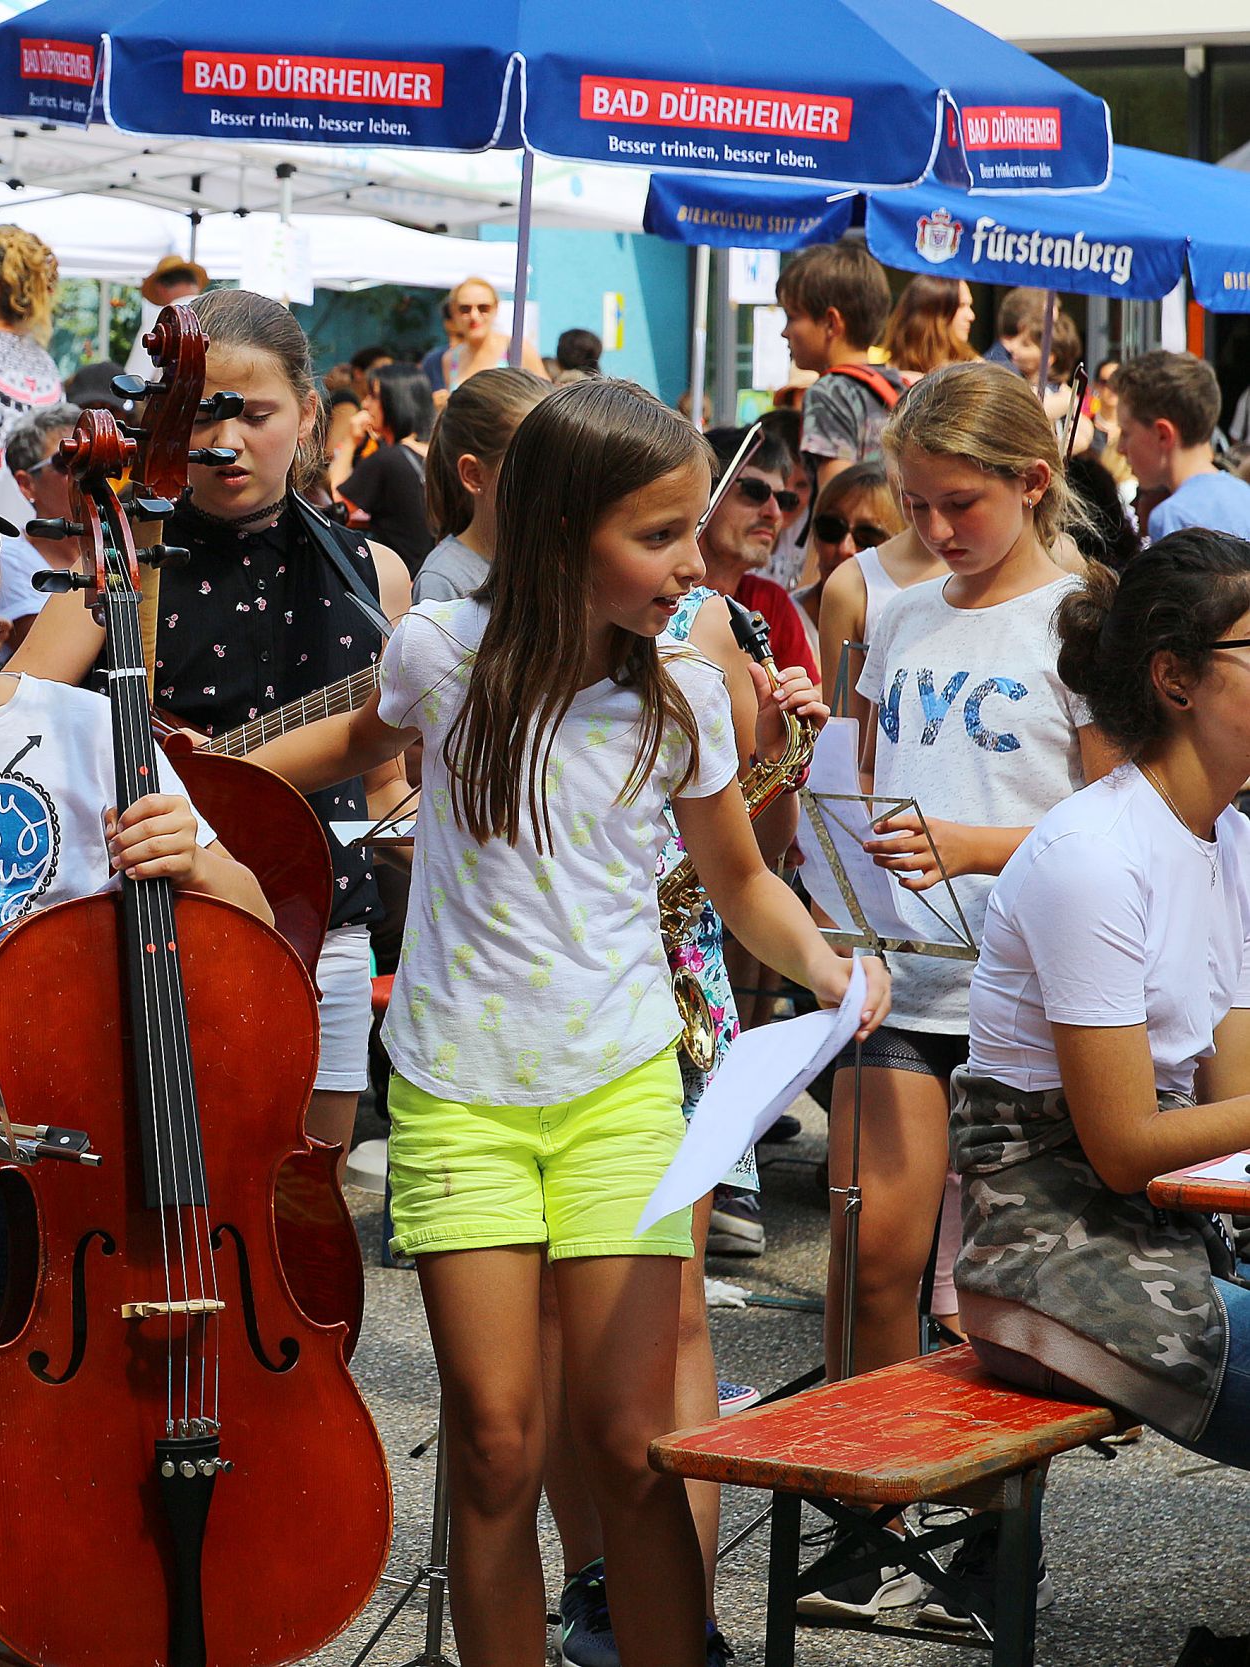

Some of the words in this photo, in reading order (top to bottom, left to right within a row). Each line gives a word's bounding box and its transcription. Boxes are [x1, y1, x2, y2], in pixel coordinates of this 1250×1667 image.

[194, 61, 247, 90] BAD
[256, 59, 432, 101] DÜRRHEIMER
[210, 108, 256, 127] Besser
[259, 112, 314, 131] trinken,
[318, 114, 365, 133] besser
[368, 118, 411, 137] leben.
[592, 86, 649, 117] BAD
[658, 87, 840, 135] DÜRRHEIMER
[967, 117, 989, 145] BAD
[607, 134, 657, 153] Besser
[660, 140, 720, 162] trinken,
[723, 144, 772, 164] besser
[775, 148, 818, 169] leben.
[971, 215, 1134, 286] Fürstenberg
